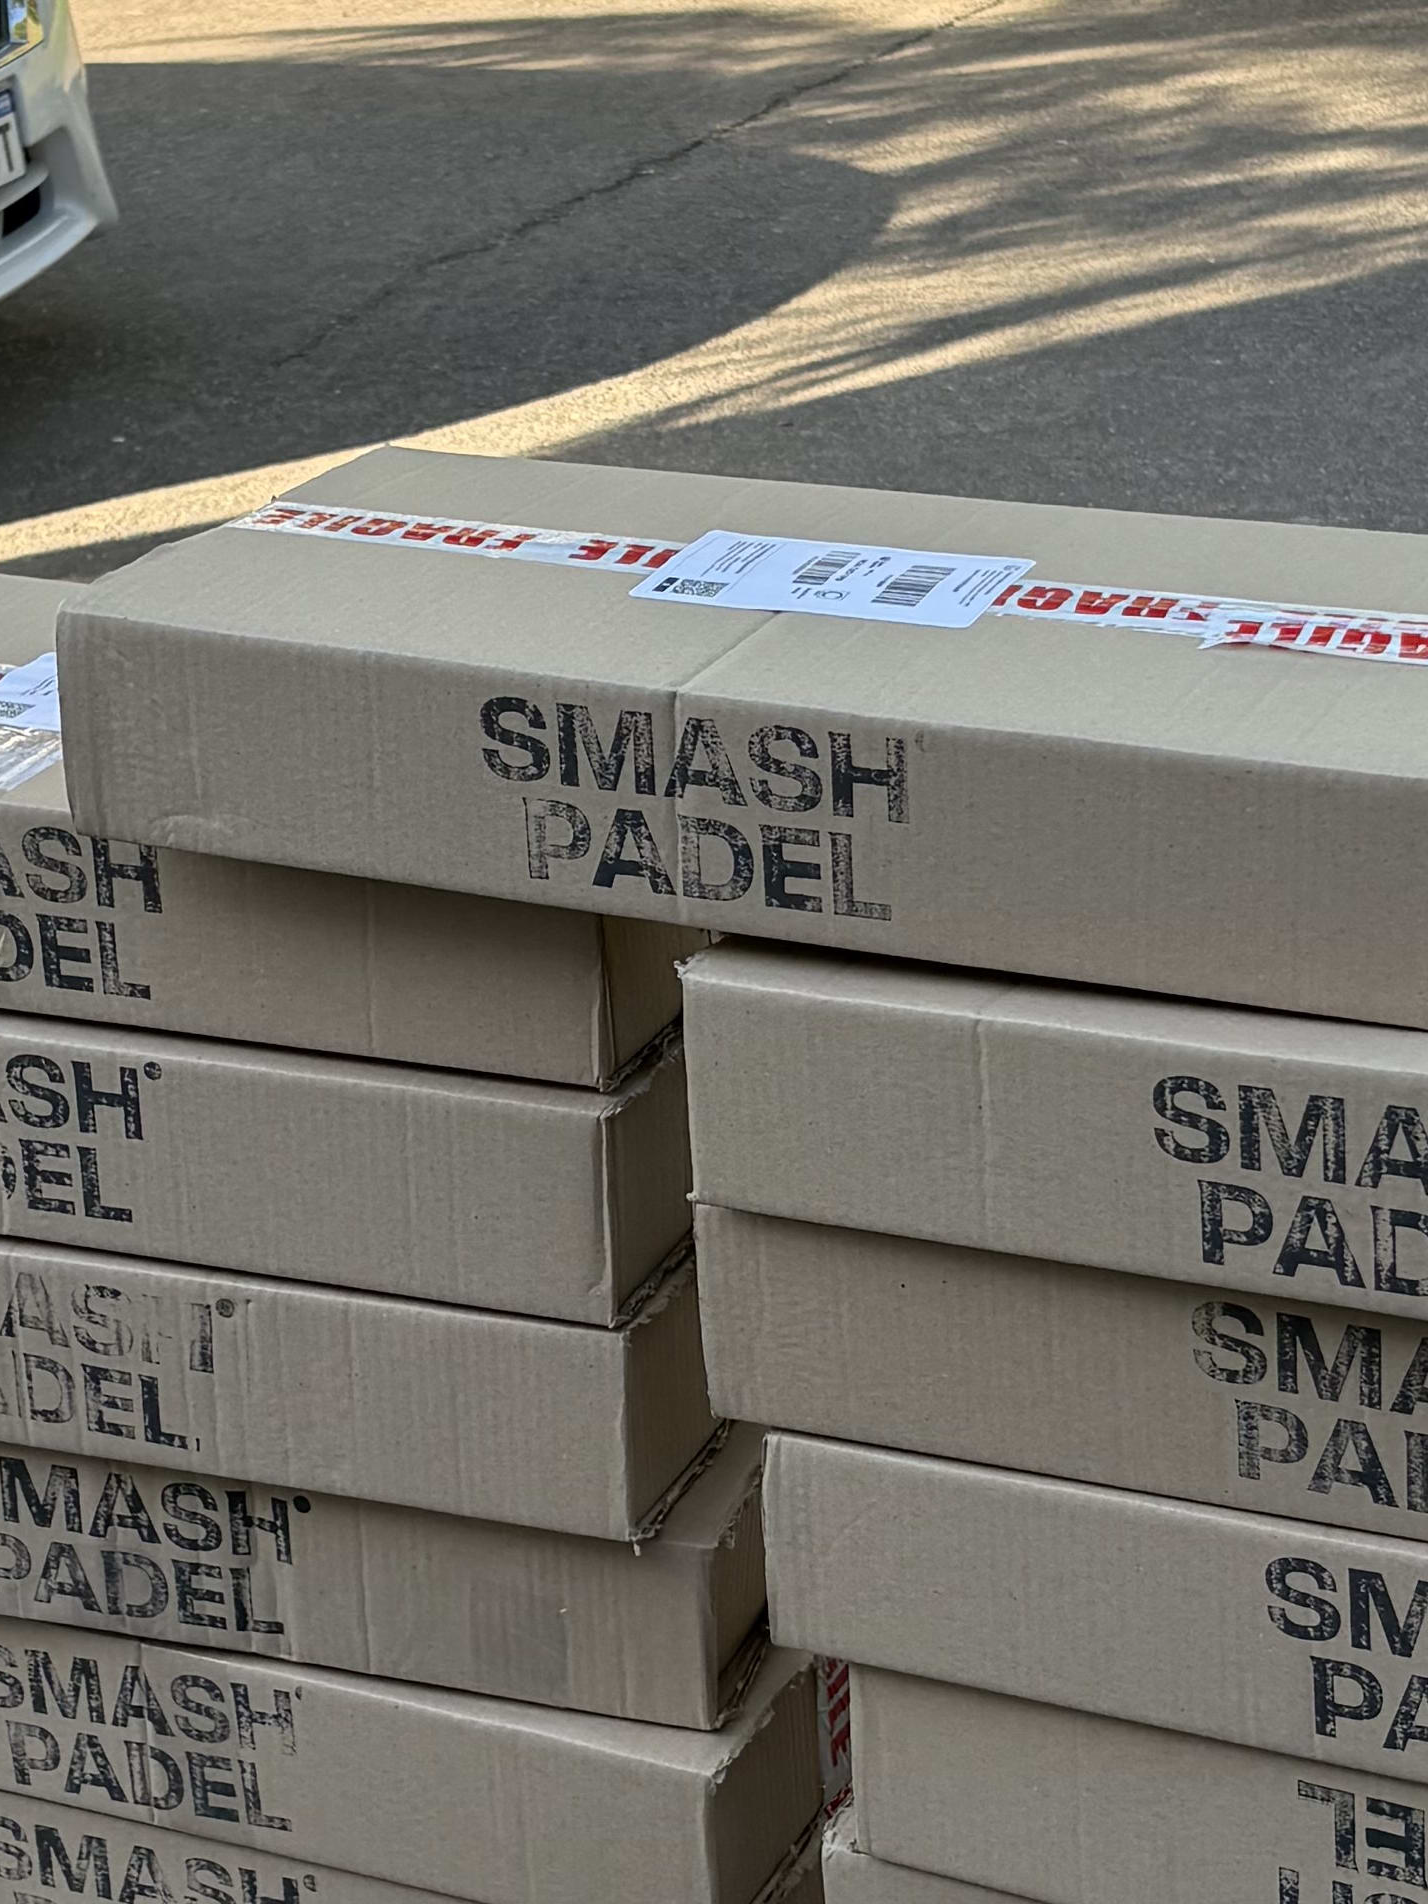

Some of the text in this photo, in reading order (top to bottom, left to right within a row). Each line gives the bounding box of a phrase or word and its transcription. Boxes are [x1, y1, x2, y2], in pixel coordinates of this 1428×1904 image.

[479, 696, 910, 824] SMASH
[522, 797, 892, 921] PADEL
[6, 1720, 293, 1832] PADEL
